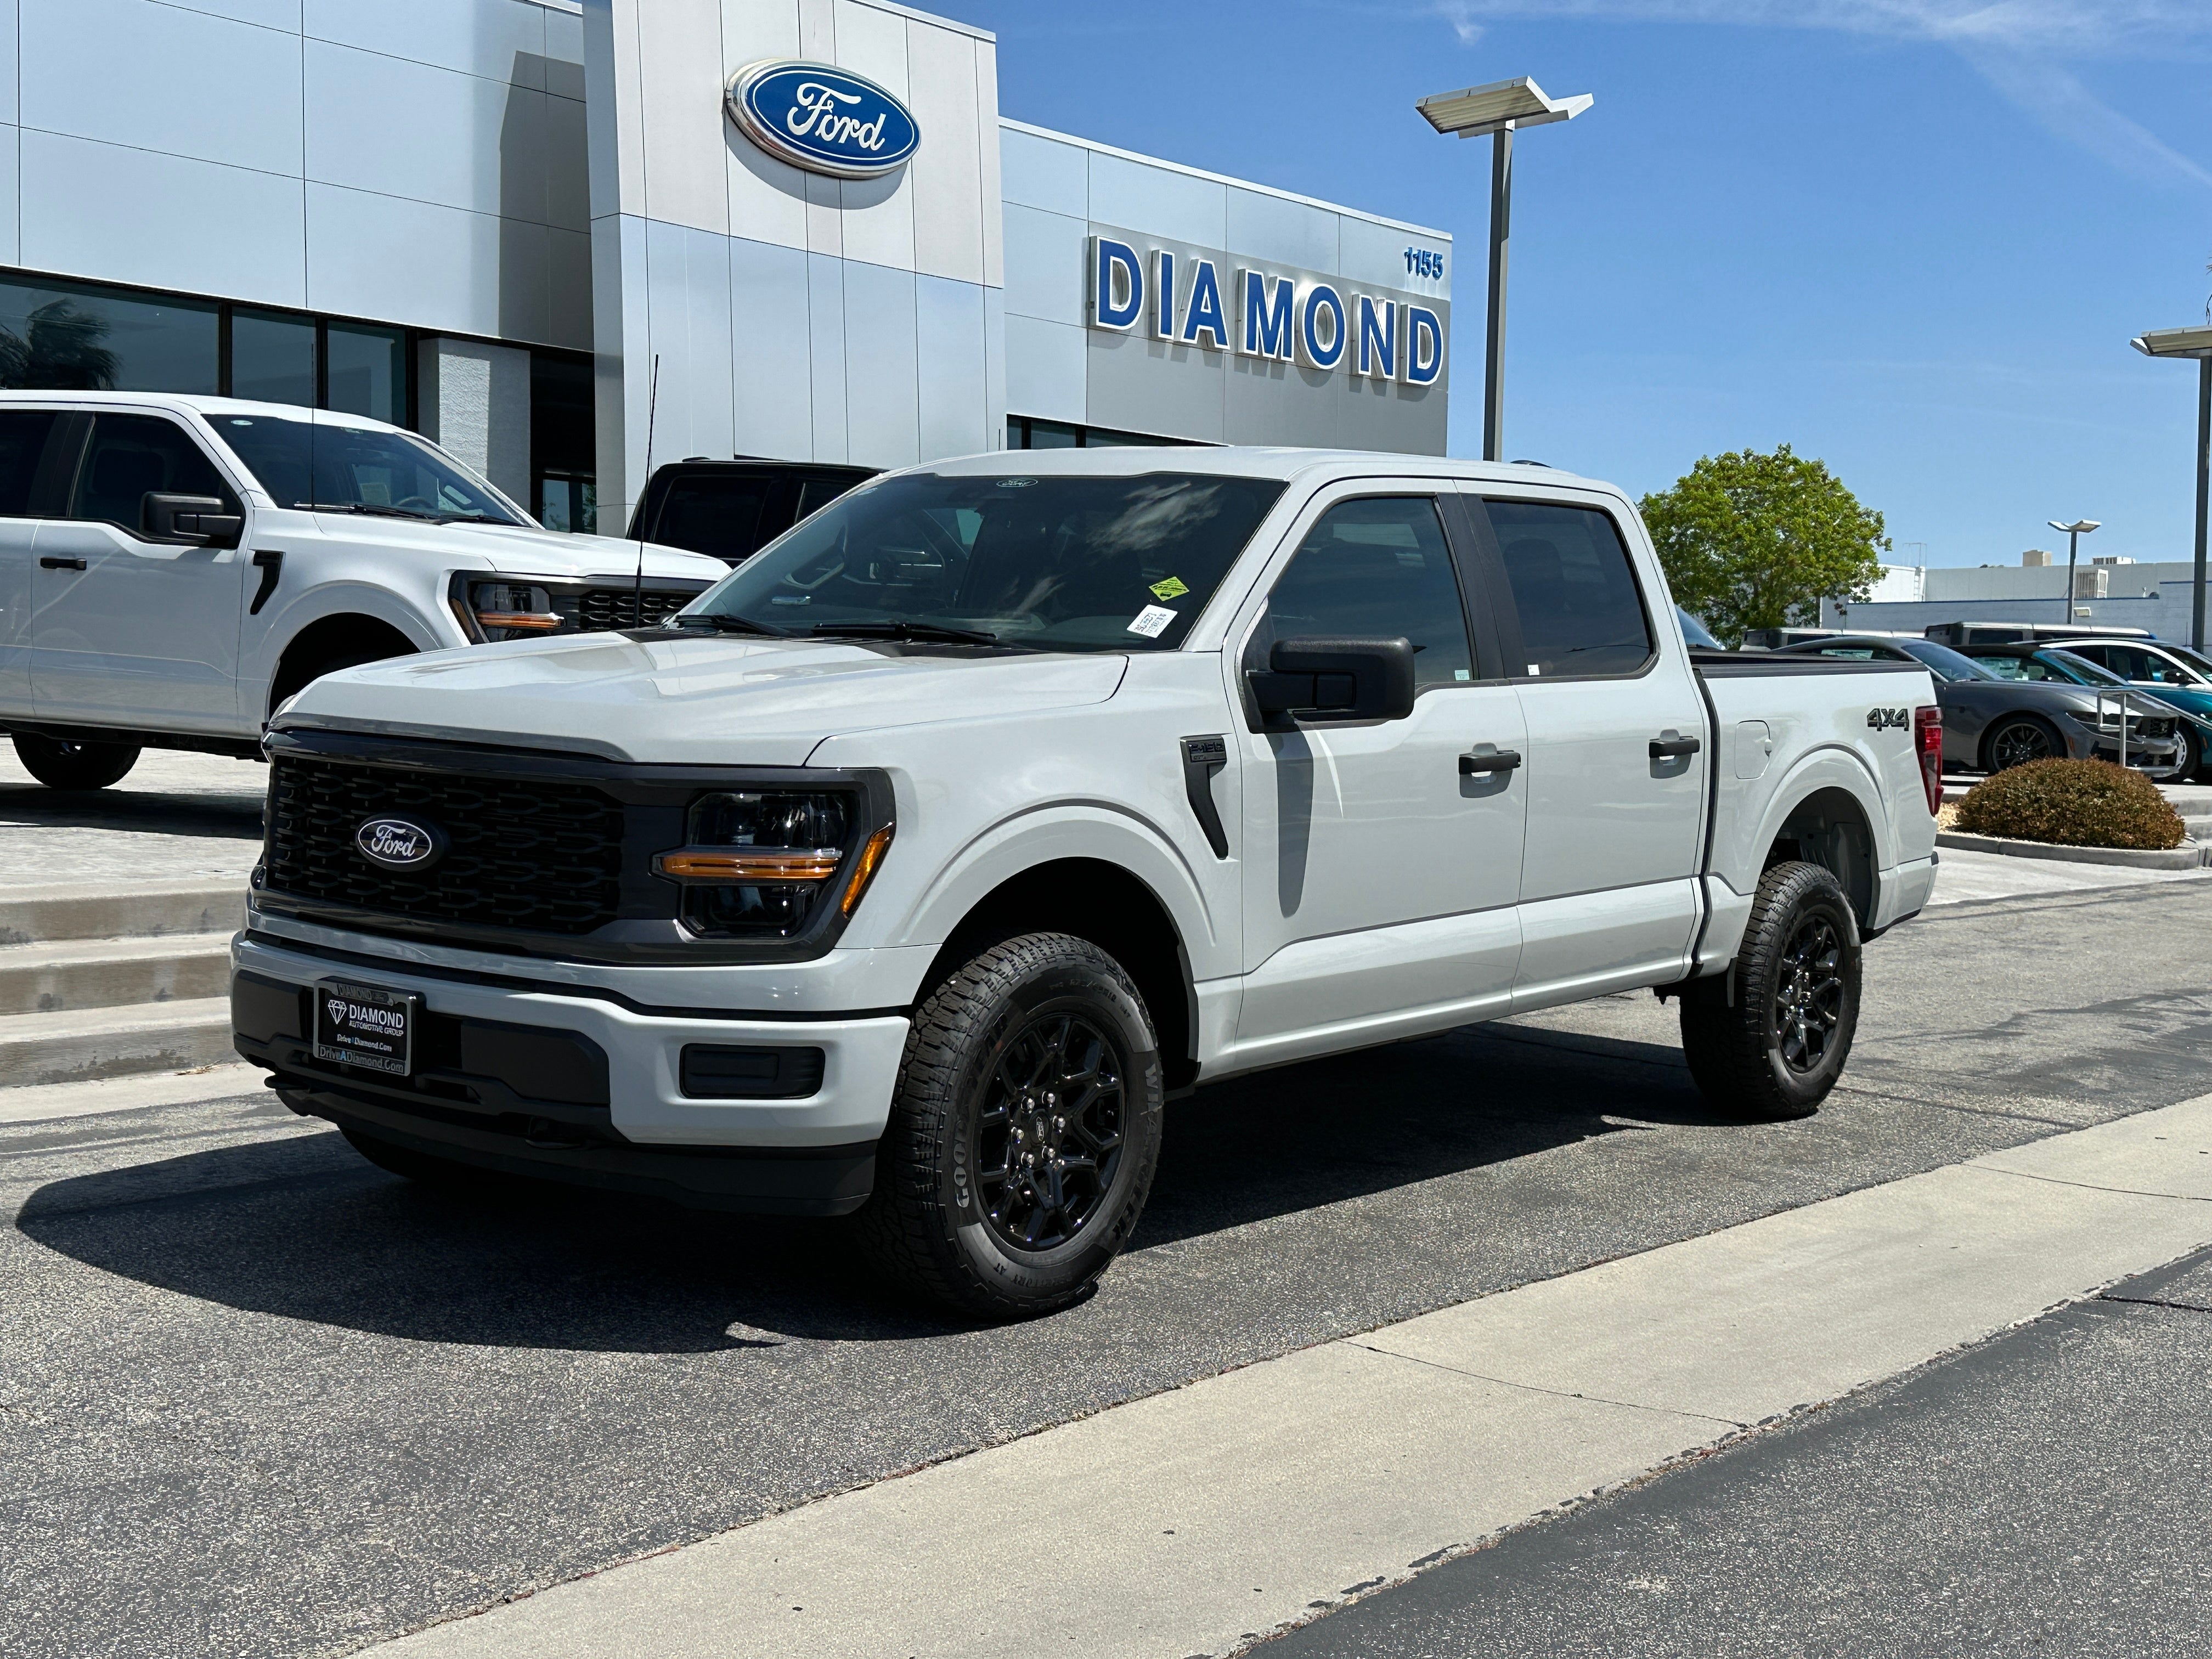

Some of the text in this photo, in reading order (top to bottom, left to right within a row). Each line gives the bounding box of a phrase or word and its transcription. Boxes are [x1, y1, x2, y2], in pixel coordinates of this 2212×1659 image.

[787, 82, 887, 151] Ford
[1404, 247, 1443, 280] 1155
[1091, 236, 1444, 385] DIAMOND
[371, 825, 417, 856] Ford
[338, 985, 372, 1000] DIAMOND
[349, 1004, 404, 1028] DIAMOND
